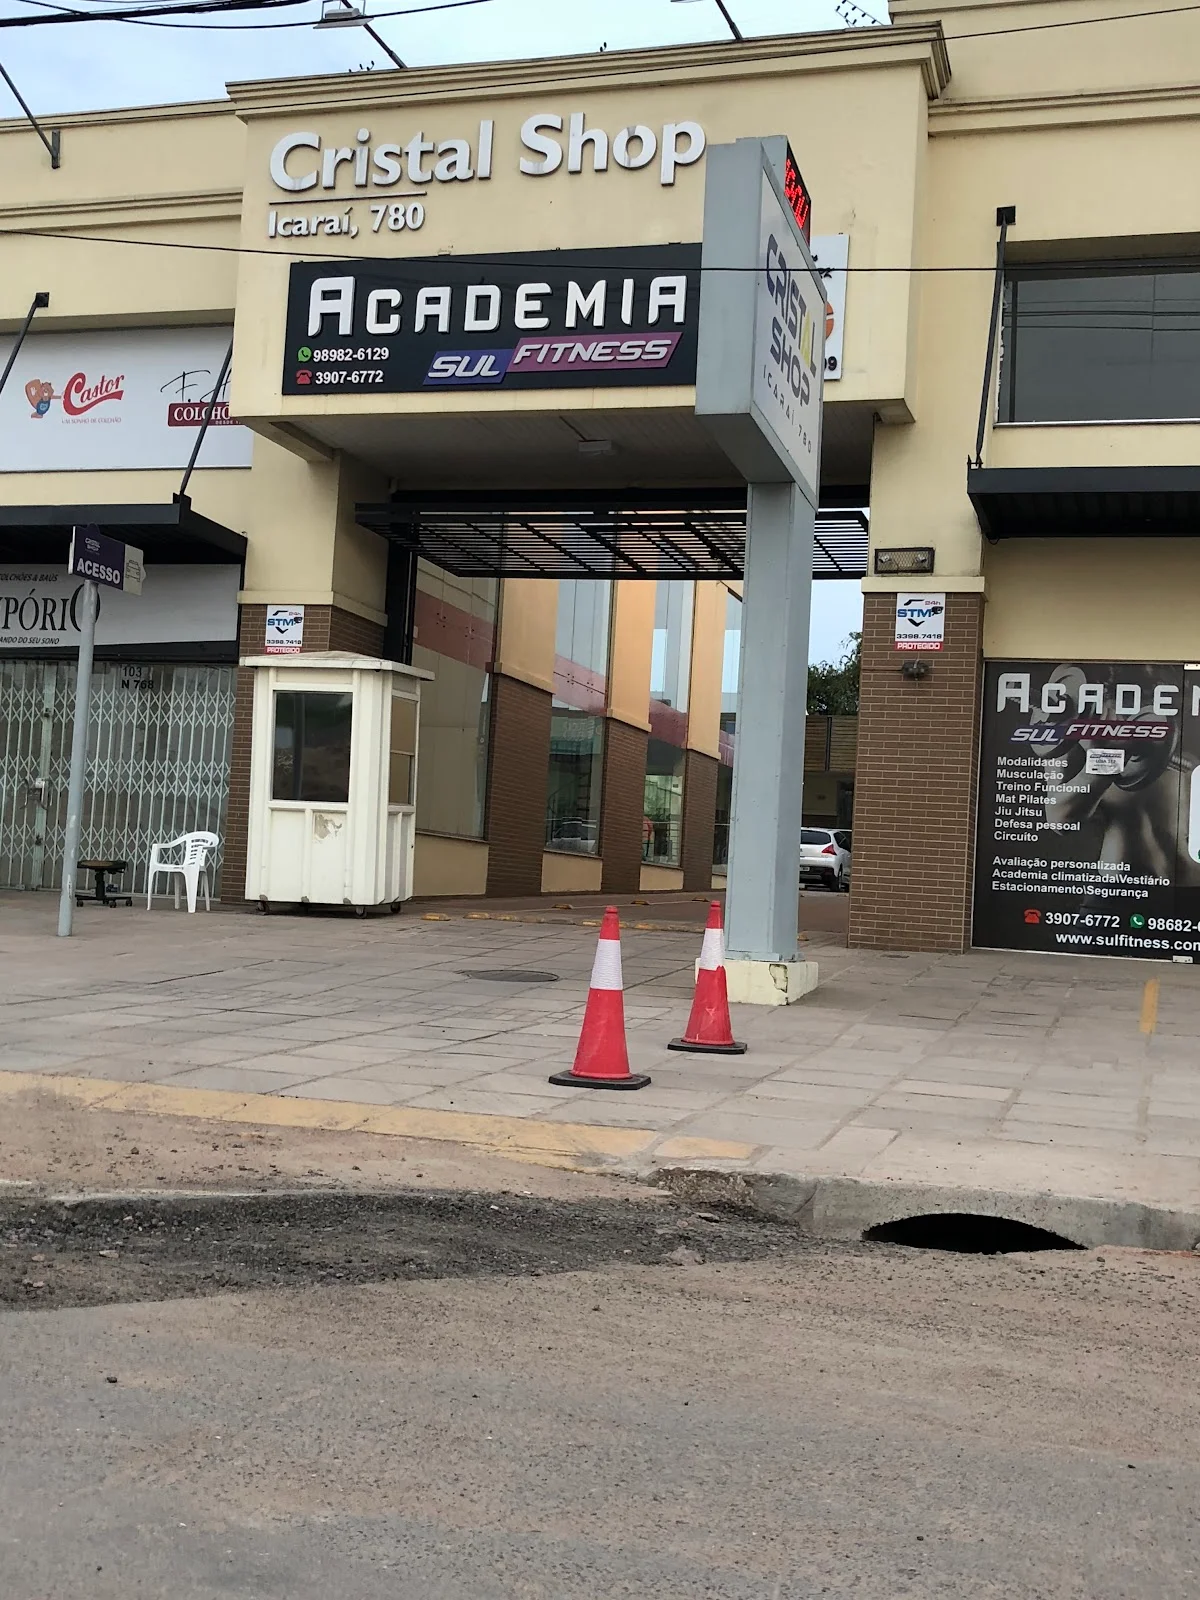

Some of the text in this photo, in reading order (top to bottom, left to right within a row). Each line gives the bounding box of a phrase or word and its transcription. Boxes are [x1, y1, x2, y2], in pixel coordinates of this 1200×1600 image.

[269, 111, 707, 192] Cristal Shop
[268, 202, 426, 239] Icaraí, 780
[307, 275, 688, 338] ACADEMIA
[766, 233, 817, 379] CRISTAL
[312, 347, 390, 363] 98982-6129
[427, 339, 672, 379] SUL FITNESS
[769, 316, 810, 408] SHOP
[315, 370, 384, 385] 3907-6772
[62, 372, 125, 416] Castor
[798, 423, 812, 454] 780
[77, 557, 121, 584] ACESSO
[0, 583, 101, 632] PÓRIO
[897, 608, 932, 618] STM
[897, 642, 941, 650] PROTEGIDO
[122, 666, 142, 677] 103
[996, 672, 1200, 717] ACADE
[1010, 723, 1169, 742] SUL FITNESS
[997, 756, 1068, 768] Modalidades
[996, 769, 1064, 781] Musculação
[995, 781, 1091, 794] Treino Funcional
[995, 793, 1057, 805] Mat Pilates
[994, 806, 1043, 817] Jiu Jitsu
[994, 818, 1081, 832] Defesa pessoal
[993, 855, 1131, 872] Avaliação personalizada
[992, 868, 1048, 880] Academia
[1045, 911, 1200, 933] 3907-6772 98682-
